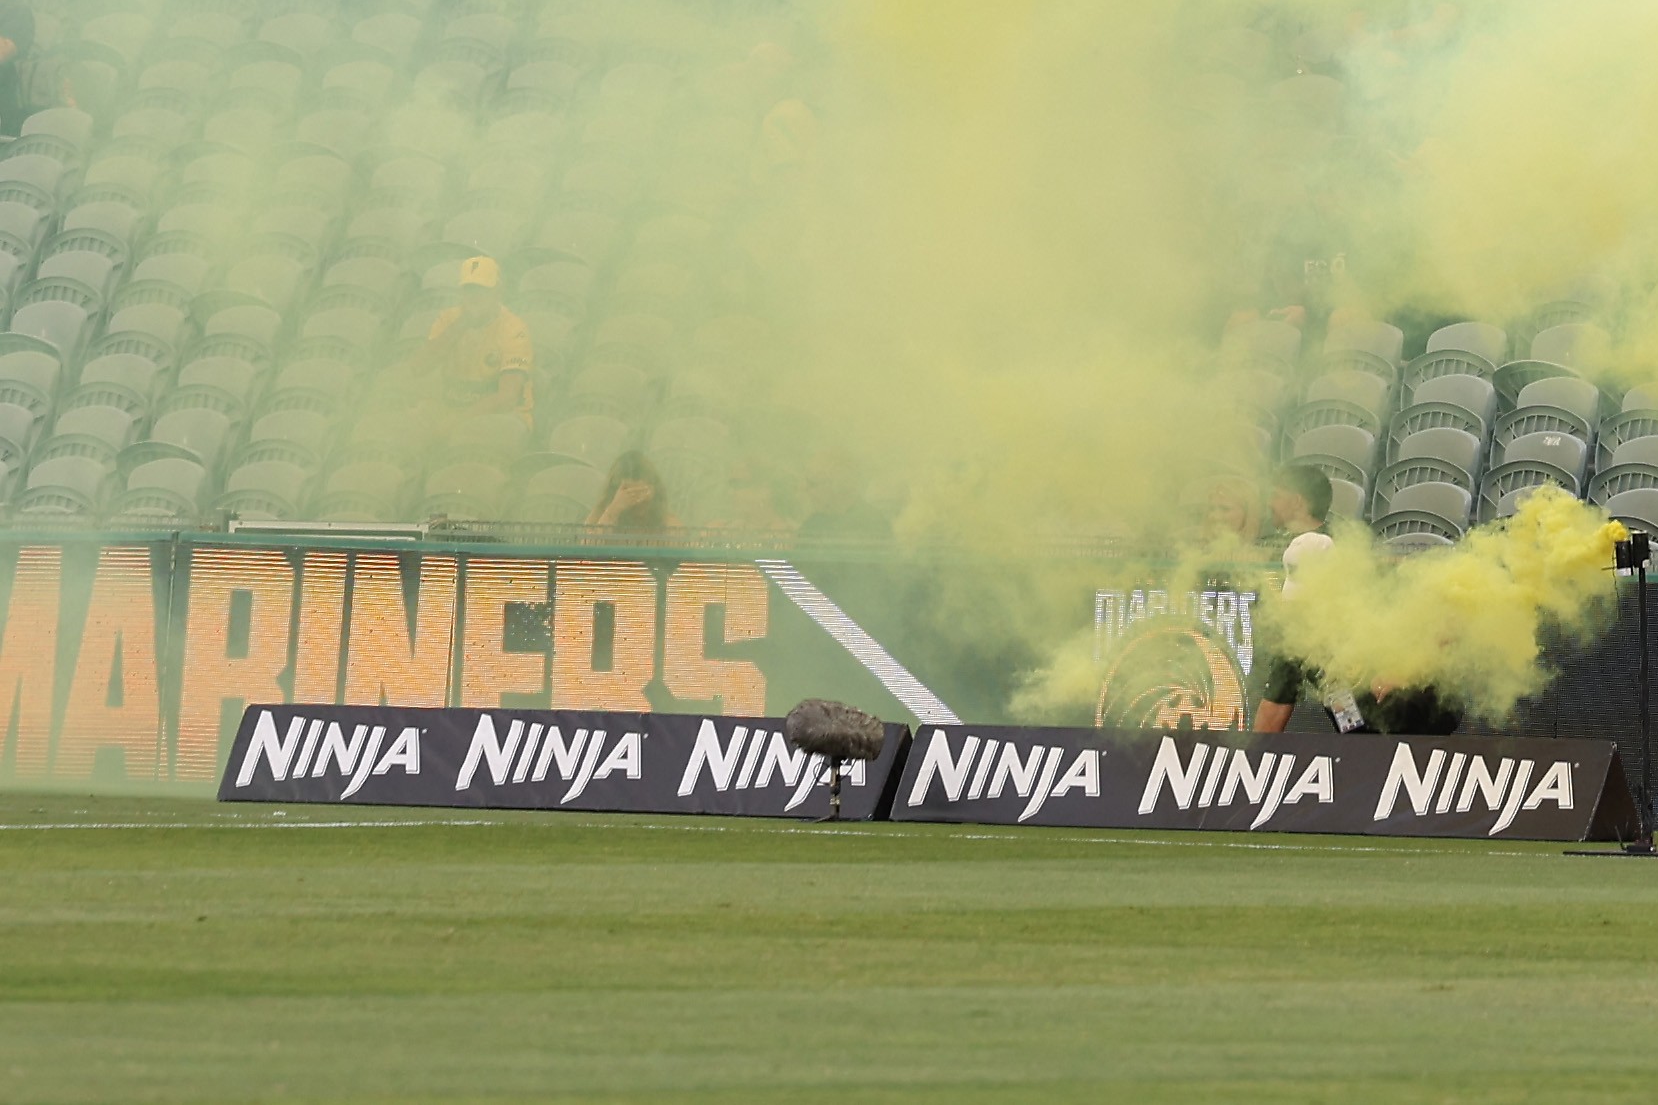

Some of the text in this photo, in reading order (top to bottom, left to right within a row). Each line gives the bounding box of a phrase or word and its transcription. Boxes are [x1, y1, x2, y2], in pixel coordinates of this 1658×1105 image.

[235, 709, 421, 801] NINJA
[455, 713, 643, 804] NINJA
[907, 729, 1101, 823] NINJA
[1136, 735, 1336, 832] NINJA
[1373, 740, 1575, 837] NINJA
